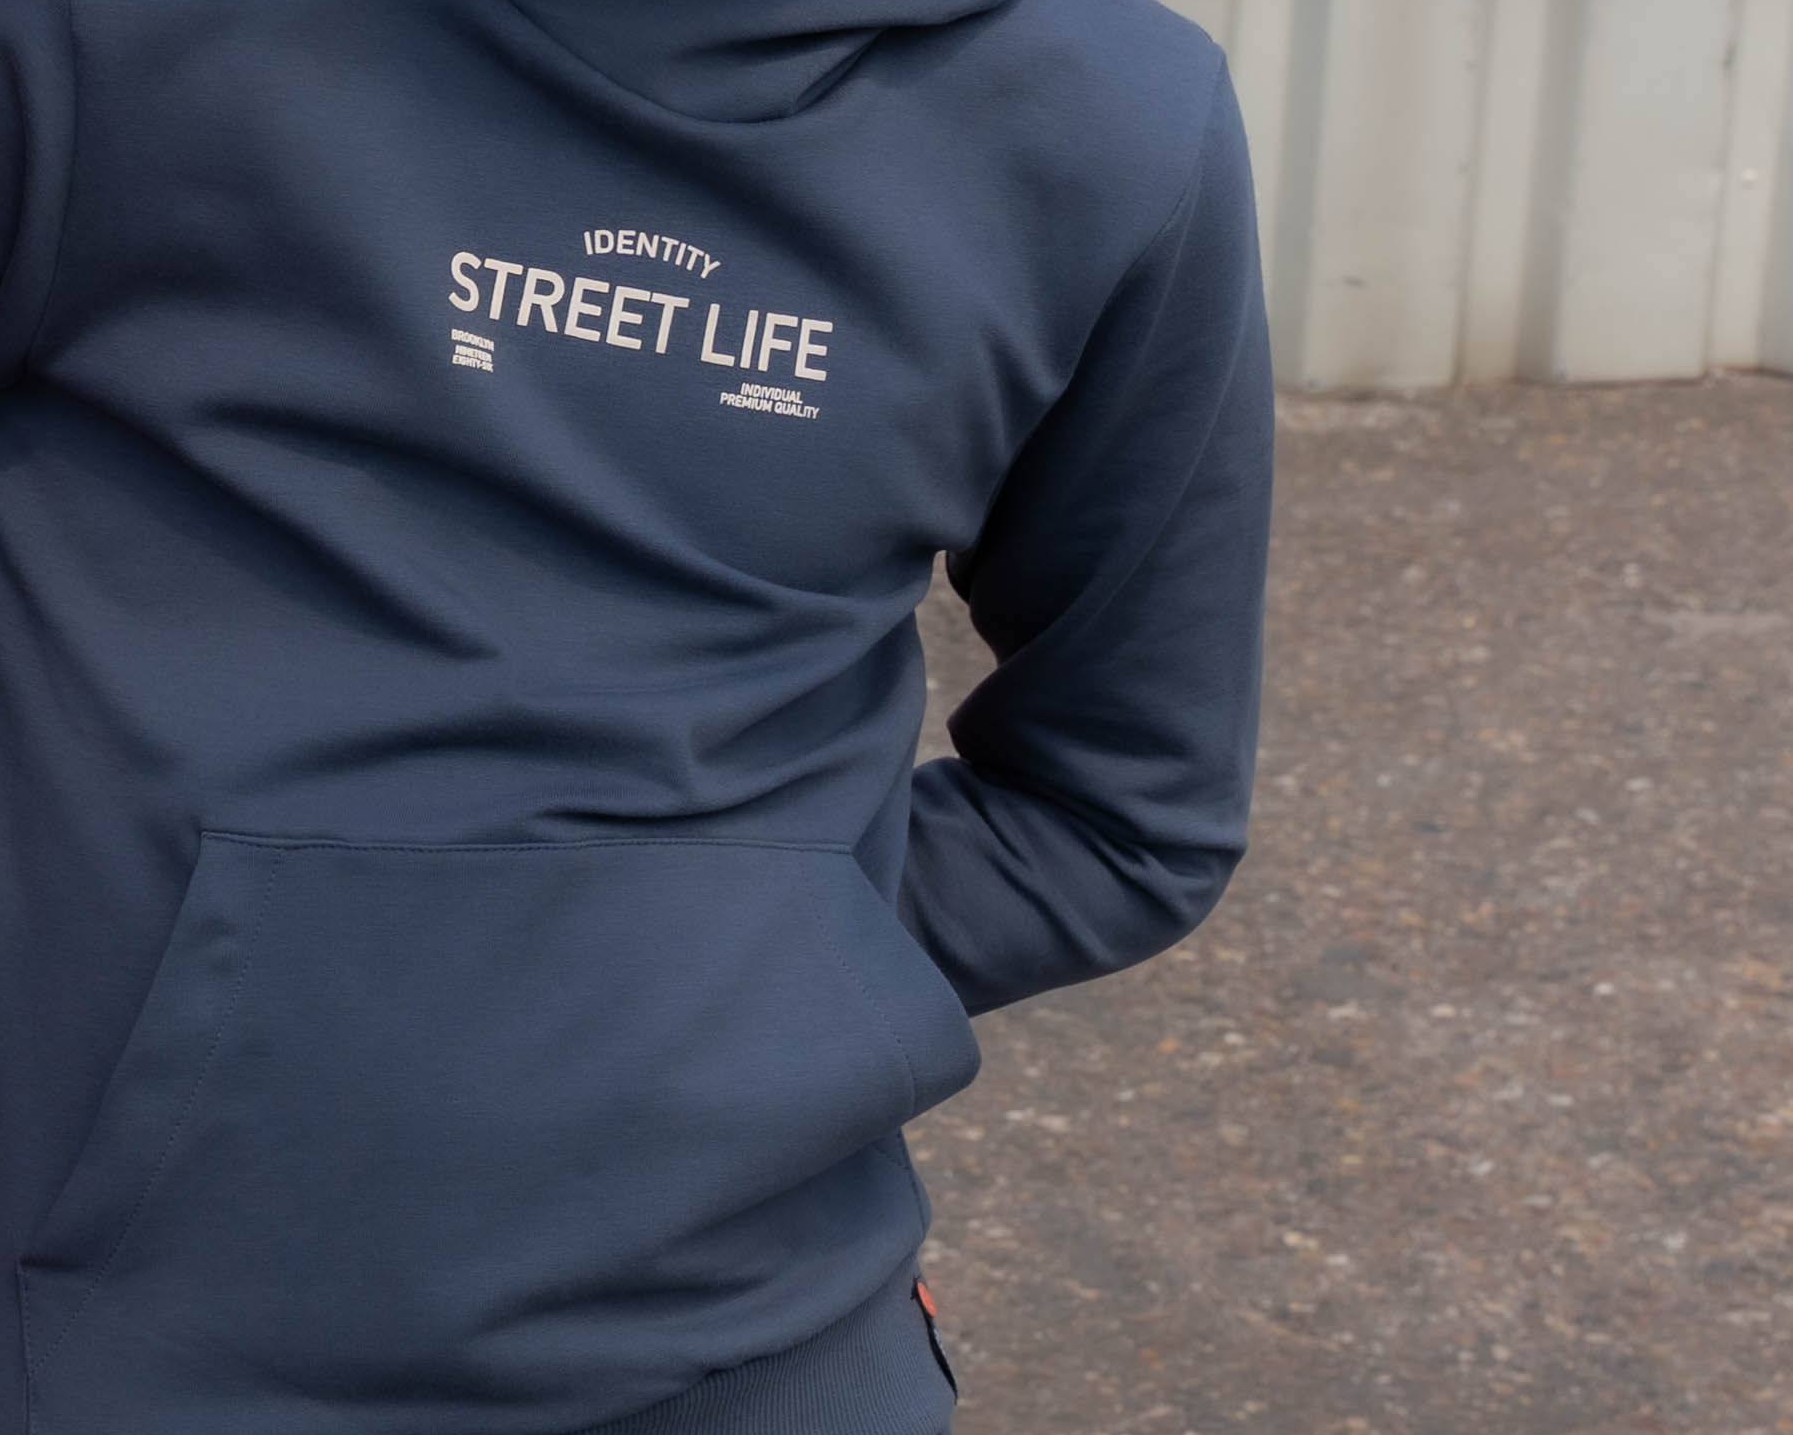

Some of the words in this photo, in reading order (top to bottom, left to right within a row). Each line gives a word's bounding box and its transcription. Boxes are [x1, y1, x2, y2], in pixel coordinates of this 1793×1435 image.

[584, 229, 720, 279] IDENTITY
[448, 251, 689, 354] STREET
[700, 303, 833, 381] LIFE
[720, 392, 773, 412] PREMIUM
[774, 401, 819, 419] QUALITY
[740, 382, 803, 404] INDIVIDUAL
